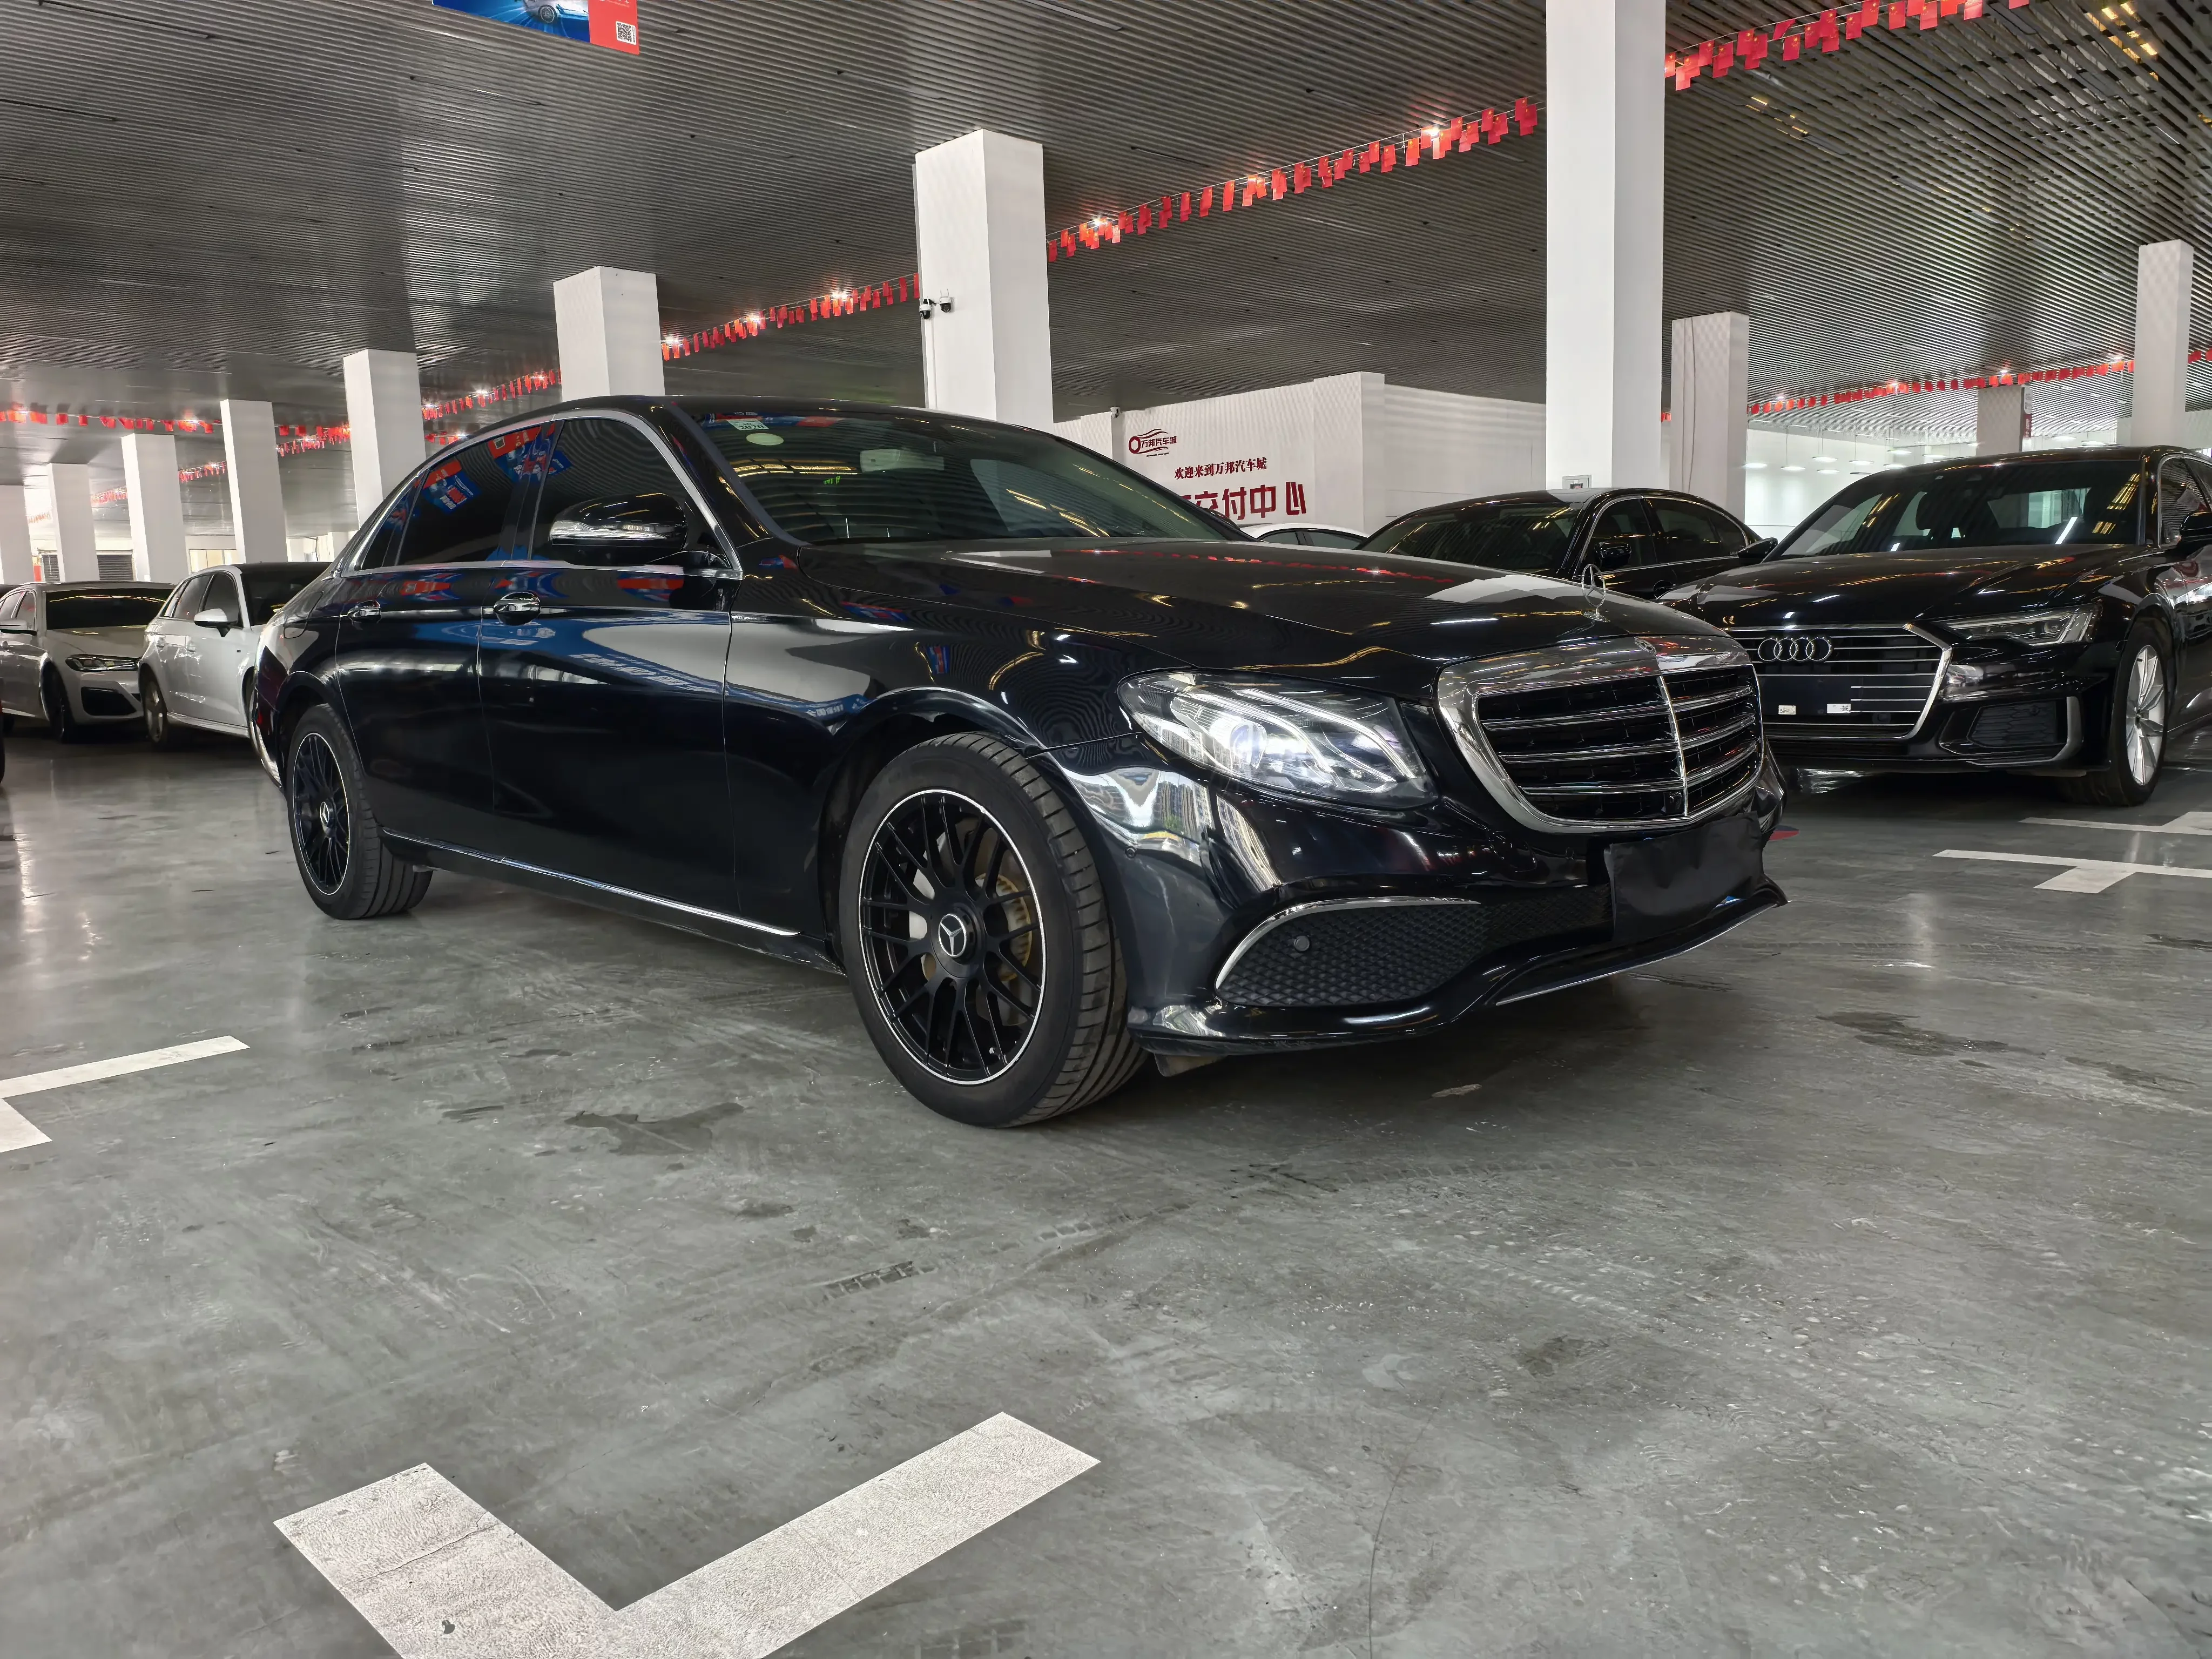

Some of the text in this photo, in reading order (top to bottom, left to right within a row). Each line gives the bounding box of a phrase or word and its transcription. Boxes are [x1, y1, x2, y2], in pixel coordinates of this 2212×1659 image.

[1141, 436, 1177, 448] 万邦汽车城
[1174, 457, 1267, 480] 欢迎来到万邦汽车城
[1179, 482, 1307, 520] 交付中心
